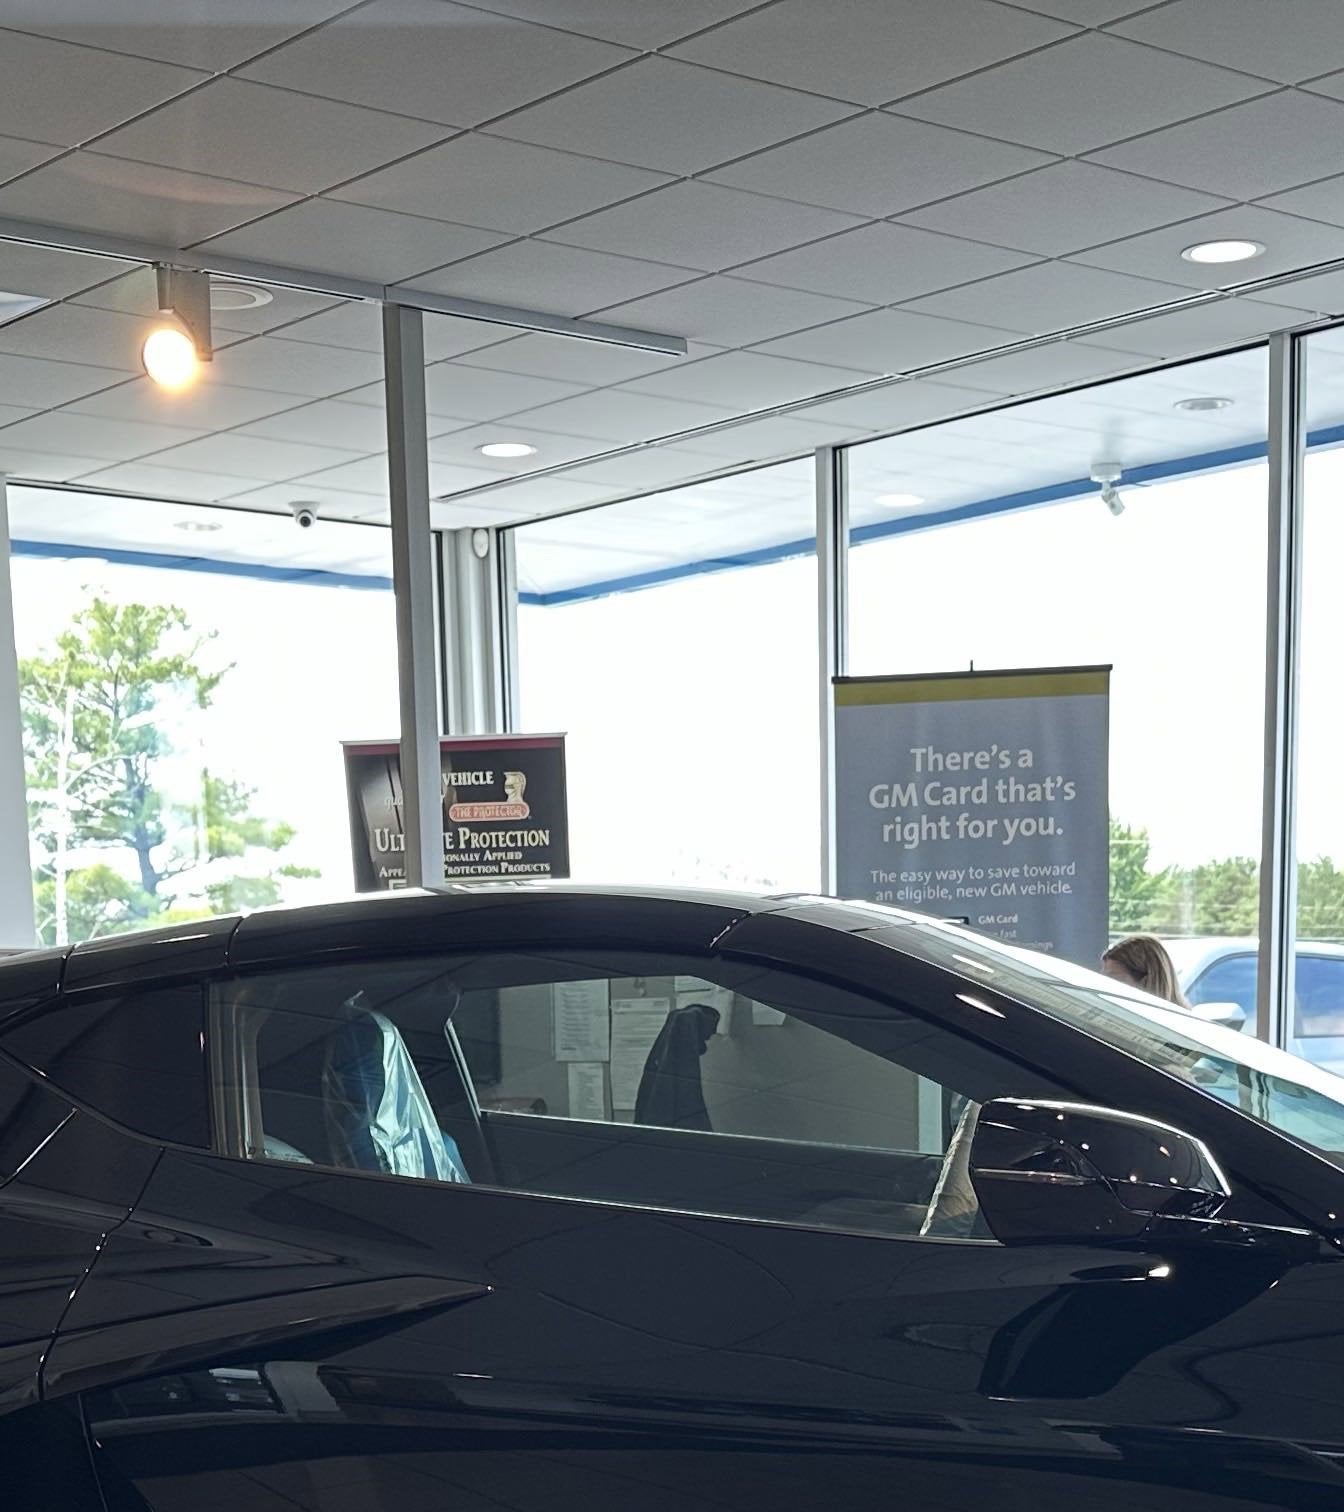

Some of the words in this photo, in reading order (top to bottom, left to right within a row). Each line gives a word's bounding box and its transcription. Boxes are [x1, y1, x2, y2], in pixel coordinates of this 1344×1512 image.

[910, 744, 1011, 772] There's
[1017, 749, 1033, 768] a
[442, 771, 494, 786] VEHICLE
[869, 783, 918, 809] GM
[924, 778, 988, 805] Card
[995, 776, 1076, 803] that's
[455, 807, 472, 818] THE
[474, 805, 522, 818] PROTECTOR
[458, 827, 550, 849] PROTECTION
[882, 815, 951, 849] right
[956, 813, 998, 839] for
[1002, 816, 1064, 845] you.
[483, 850, 523, 861] APPLIED
[443, 863, 498, 875] PROTECTION
[500, 862, 551, 873] PRODUCTS
[871, 869, 897, 884] The
[900, 870, 932, 886] easy
[935, 869, 965, 883] way
[968, 866, 984, 880] to
[987, 867, 1020, 880] save
[1023, 862, 1076, 877] toward
[875, 890, 893, 902] an
[897, 885, 953, 904] eligible,
[956, 887, 987, 898] new
[990, 883, 1017, 897] GM
[1020, 881, 1073, 895] vehicle.
[978, 915, 995, 924] GM
[996, 914, 1018, 923] Card
